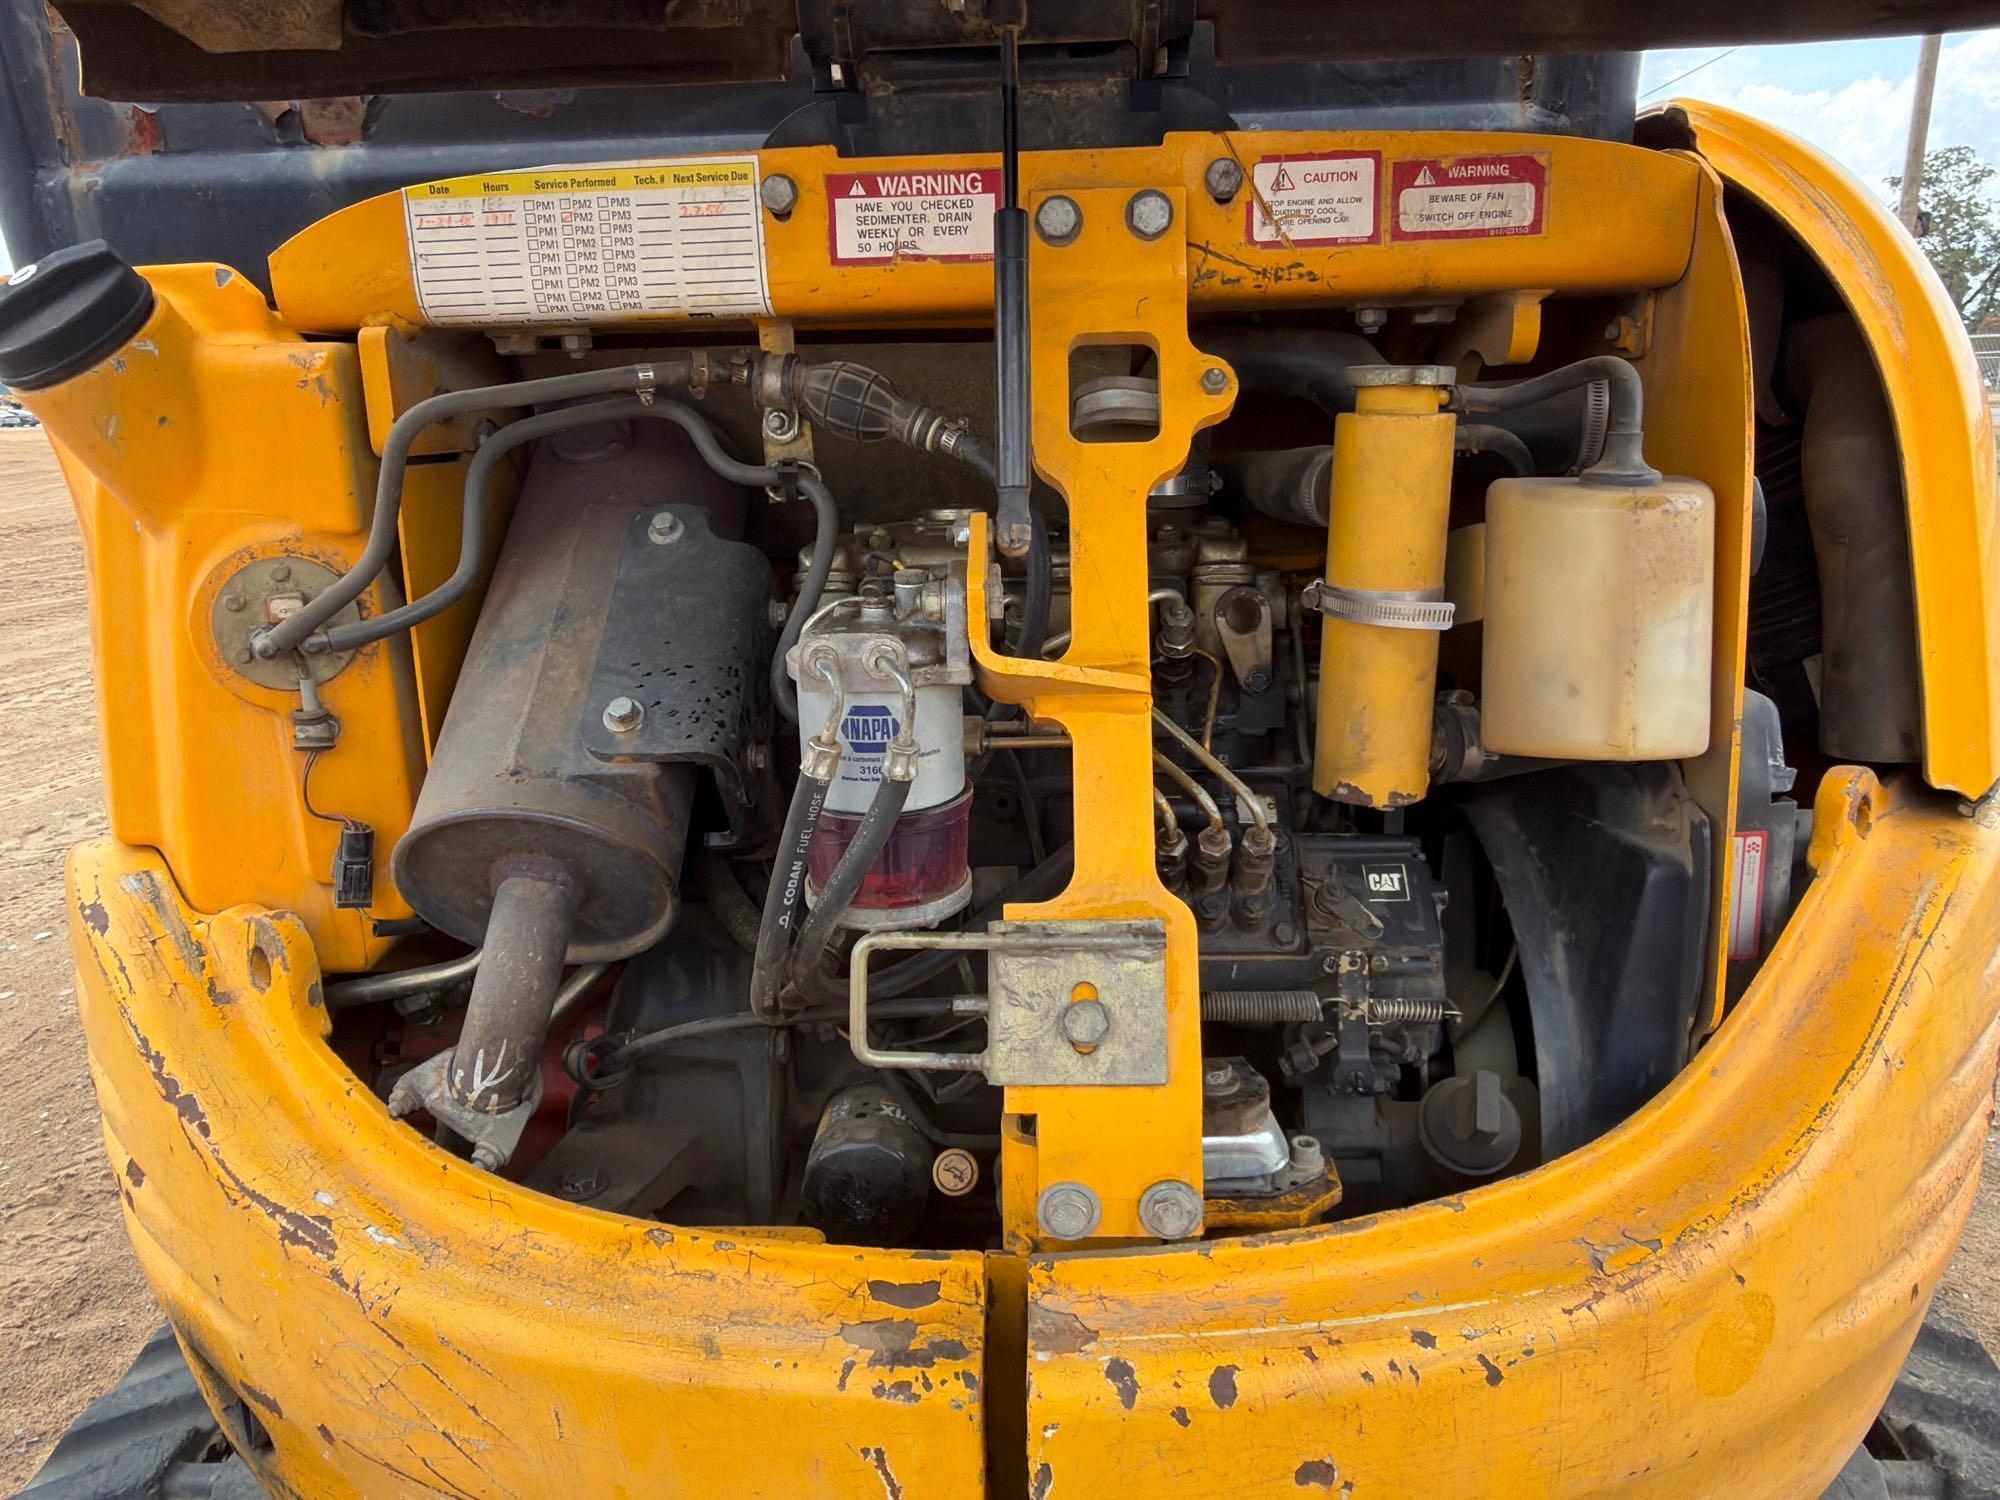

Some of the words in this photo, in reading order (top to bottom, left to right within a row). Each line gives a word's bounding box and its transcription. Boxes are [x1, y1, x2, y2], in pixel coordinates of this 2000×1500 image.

[1303, 171, 1358, 184] CAUTION
[1448, 163, 1510, 179] WARNING
[429, 185, 449, 195] Date
[483, 182, 509, 192] Hours
[534, 179, 568, 190] Service
[570, 177, 616, 188] Performed
[634, 175, 658, 185] Tech.
[659, 174, 665, 184] #
[673, 173, 695, 183] Next
[695, 171, 729, 182] Service
[731, 171, 748, 181] Due
[877, 173, 982, 196] WARNING
[1287, 198, 1315, 206] ENGINE
[1318, 197, 1333, 206] AND
[1337, 196, 1363, 204] ALLOW
[1428, 193, 1467, 203] BEWARE
[1470, 192, 1482, 202] OF
[1487, 192, 1505, 201] FAN
[536, 201, 555, 211] PM1
[572, 199, 592, 209] PM2
[610, 198, 631, 208] PM3
[855, 202, 883, 213] HAVE
[891, 201, 913, 211] YOU
[920, 198, 974, 210] CHECKED
[537, 214, 556, 224] PM1
[574, 212, 593, 222] PM2
[611, 210, 632, 220] PM3
[1271, 209, 1301, 217] ADIATOR
[1317, 207, 1338, 215] COOL
[1419, 212, 1454, 222] SWITCH
[1457, 211, 1475, 221] OFF
[1480, 209, 1513, 219] ENGINE
[856, 213, 930, 226] SEDIMENTER.
[938, 212, 972, 223] DRAIN
[1297, 217, 1331, 226] OPENING
[1334, 216, 1351, 224] CAP.
[538, 227, 558, 237] PM1
[575, 225, 595, 235] PM2
[613, 224, 633, 234] PM3
[857, 227, 899, 239] WEEKLY
[908, 227, 924, 237] OR
[933, 225, 969, 236] EVERY
[540, 240, 559, 249] PM1
[576, 239, 597, 248] PM2
[614, 237, 634, 246] PM3
[857, 242, 872, 253] 50
[541, 253, 560, 263] PM1
[577, 251, 597, 261] PM2
[615, 250, 635, 259] PM3
[543, 266, 562, 276] PM1
[579, 265, 599, 274] PM2
[616, 263, 637, 272] PM3
[544, 280, 564, 289] PM1
[580, 279, 600, 288] PM2
[618, 277, 638, 286] PM3
[546, 293, 566, 302] PM1
[582, 292, 603, 300] PM2
[620, 290, 640, 299] PM3
[550, 305, 569, 313] PM1
[622, 302, 643, 310] PM3
[850, 717, 891, 740] NAPA
[783, 860, 803, 906] CODAN
[796, 827, 813, 853] FUEL
[807, 792, 824, 820] HOSE
[1368, 873, 1402, 891] CAT
